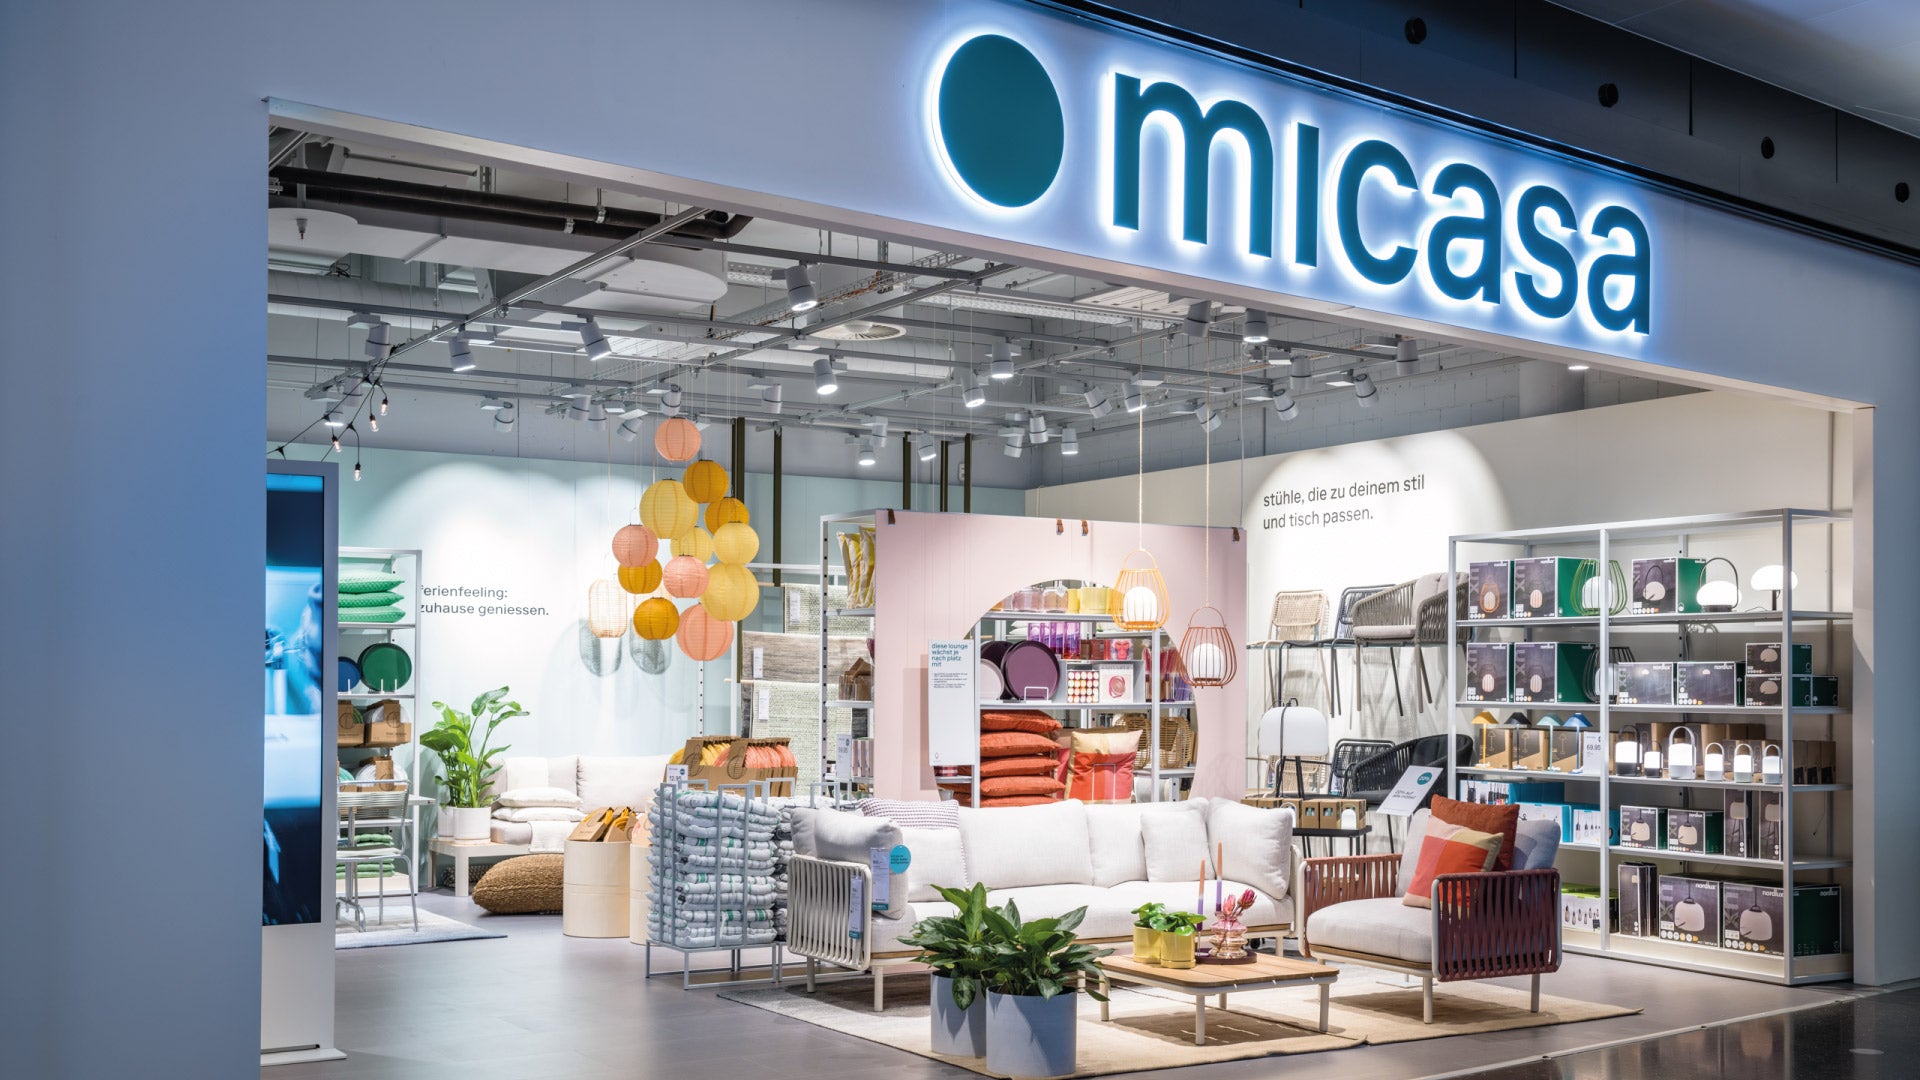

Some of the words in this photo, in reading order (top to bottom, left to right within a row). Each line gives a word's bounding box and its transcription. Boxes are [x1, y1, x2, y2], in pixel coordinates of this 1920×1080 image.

[1113, 72, 1650, 335] micasa
[1263, 490, 1304, 507] stühle,
[1308, 487, 1327, 501] die
[1330, 487, 1345, 499] zu
[1349, 481, 1399, 497] deinem
[1403, 474, 1425, 491] stil
[1263, 514, 1285, 529] und
[1289, 511, 1319, 527] tisch
[1323, 508, 1373, 527] passen.
[478, 604, 549, 616] geniessen.
[1695, 882, 1716, 890] nordlux
